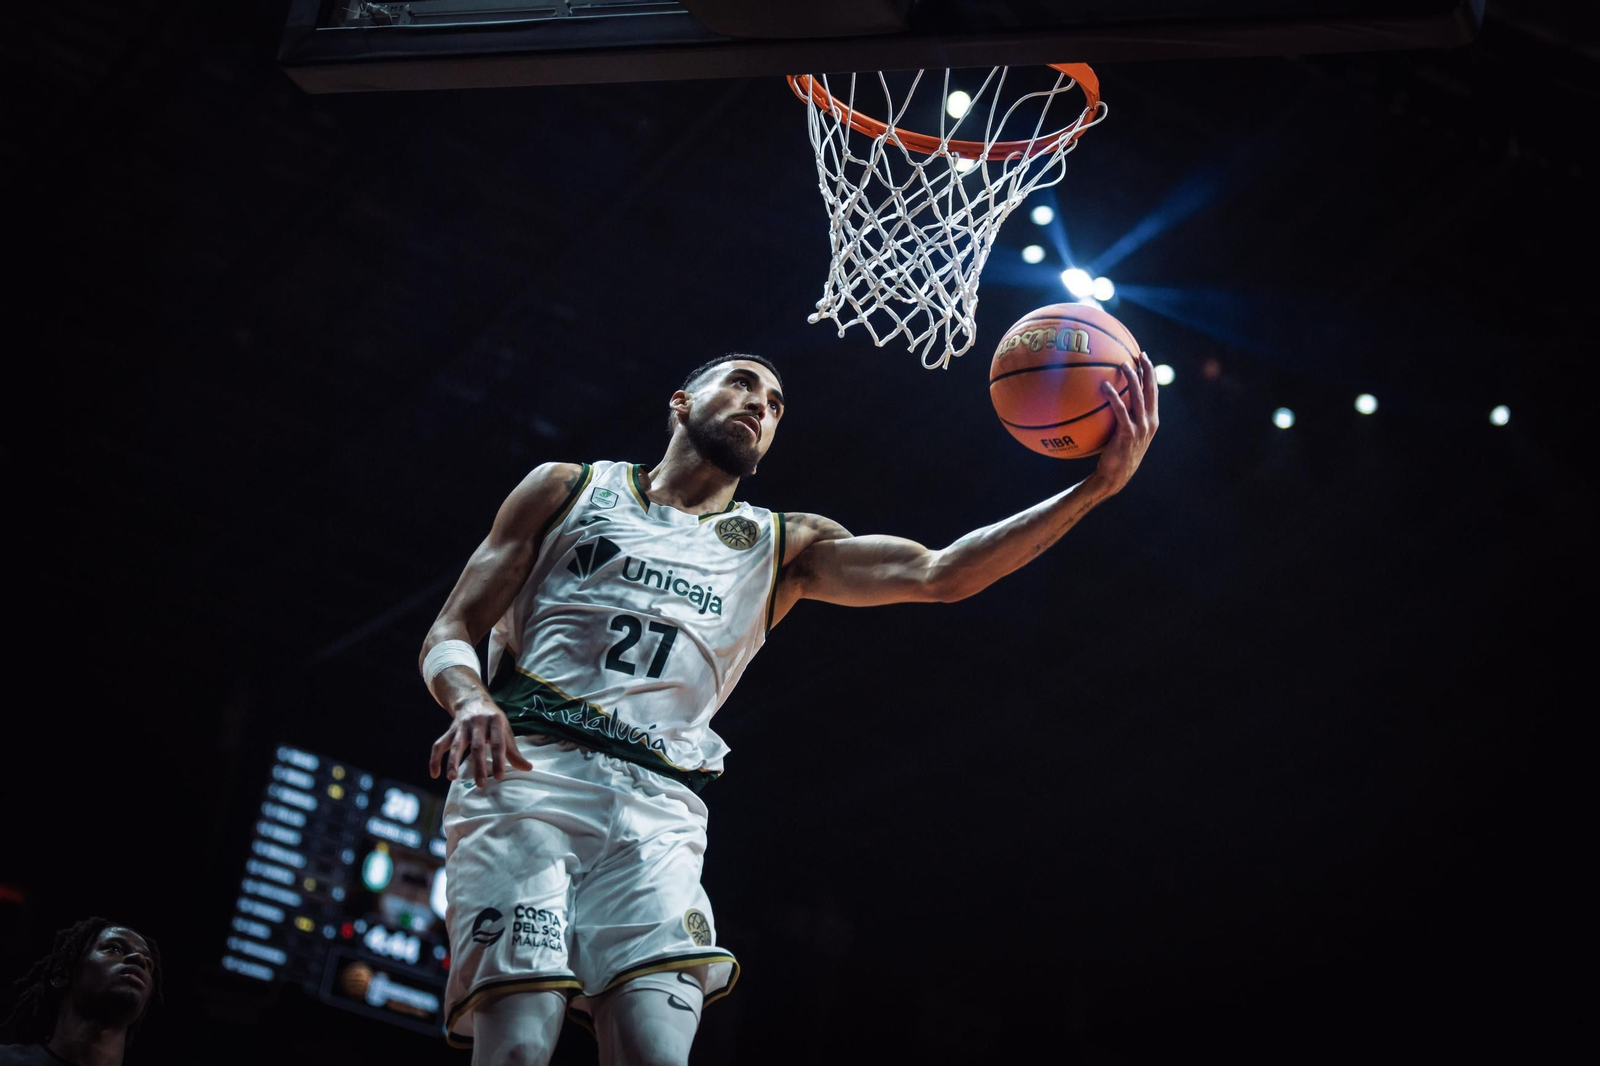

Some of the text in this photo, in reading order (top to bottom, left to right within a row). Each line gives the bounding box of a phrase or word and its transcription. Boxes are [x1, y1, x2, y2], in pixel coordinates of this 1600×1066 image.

[1040, 435, 1075, 449] FIBA
[622, 556, 722, 616] Unicaja
[605, 614, 678, 678] 27
[519, 695, 673, 763] Andalucía
[513, 921, 539, 934] DEL
[514, 904, 561, 928] COSTA
[512, 934, 563, 952] MÁLAGA
